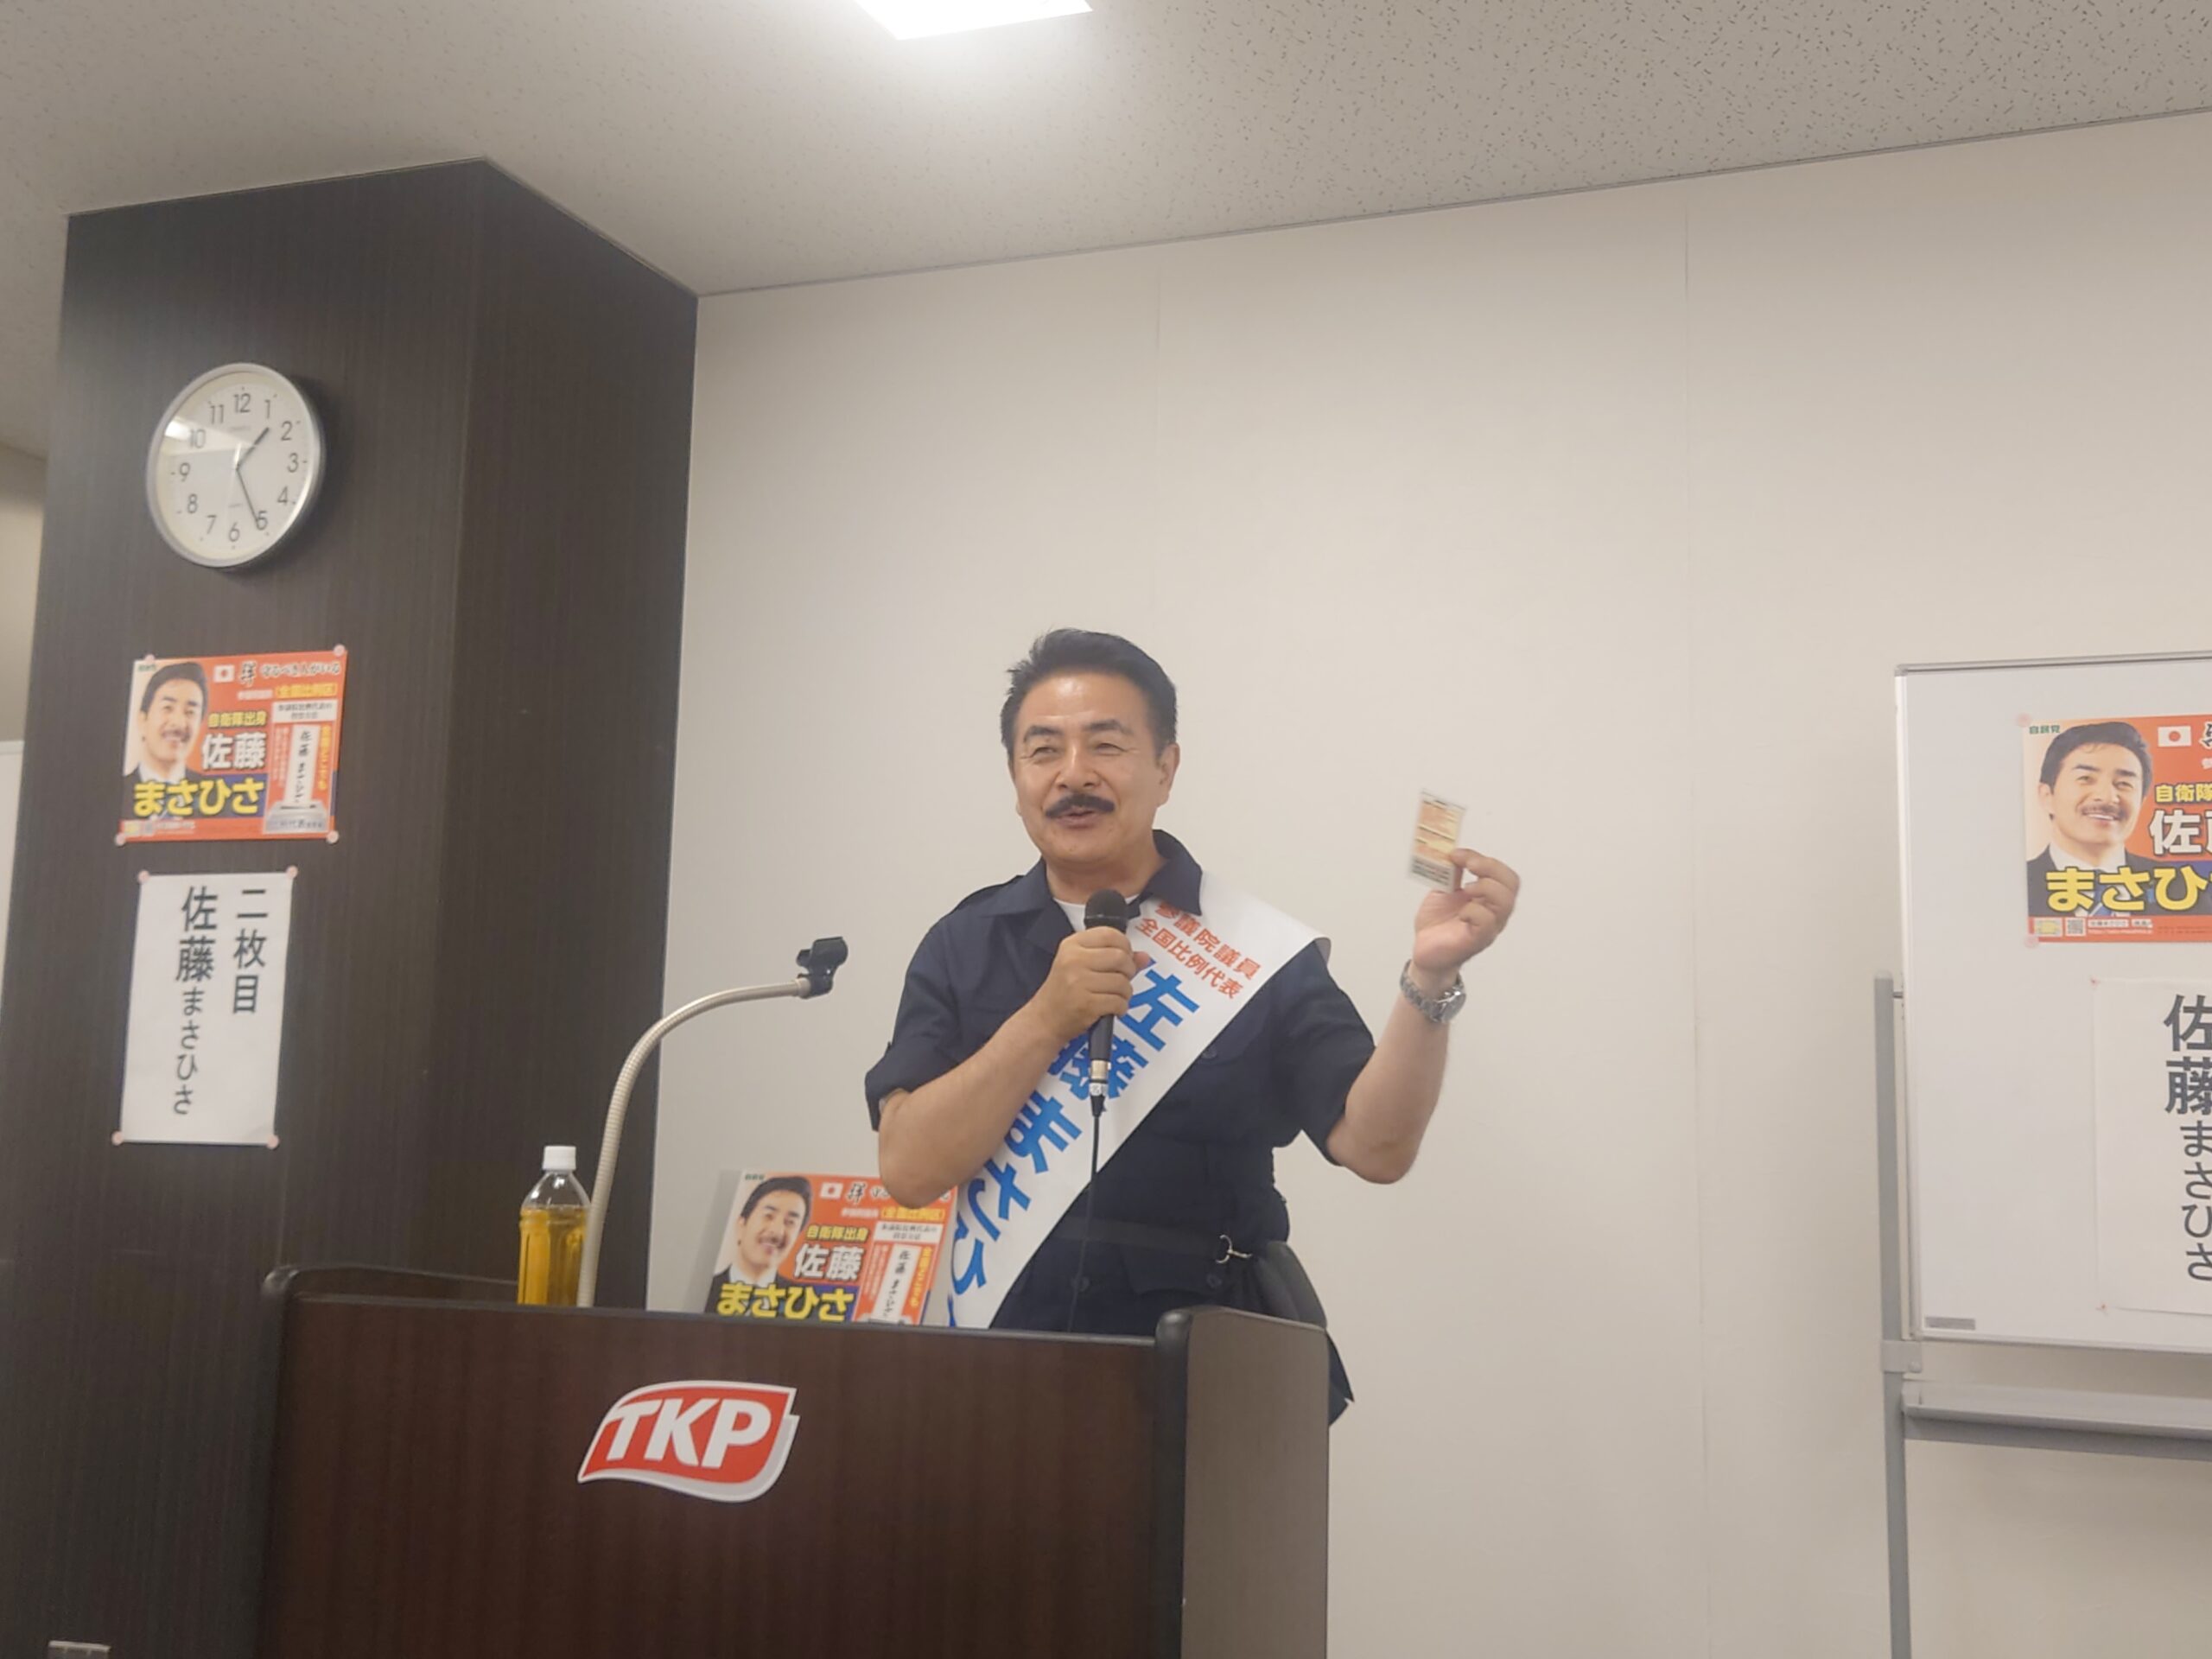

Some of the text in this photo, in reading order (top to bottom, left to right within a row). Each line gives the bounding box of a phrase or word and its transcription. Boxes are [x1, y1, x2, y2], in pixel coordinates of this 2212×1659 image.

[233, 393, 251, 413] 12
[264, 399, 271, 419] 1
[211, 404, 225, 424] 11
[190, 429, 207, 448] 10
[281, 421, 293, 441] 2
[179, 462, 191, 482] 9
[287, 453, 299, 473] 3
[187, 493, 199, 513] 8
[276, 486, 289, 505] 4
[207, 515, 218, 535] 7
[257, 510, 269, 531] 5
[228, 522, 241, 542] 6
[208, 711, 267, 728] 自衛隊出身
[2029, 724, 2061, 735] 自民党
[201, 731, 267, 770] 佐藤
[134, 778, 264, 817] まさひさ
[2148, 809, 2212, 856] 佐
[2045, 865, 2212, 912] まさひ
[232, 888, 269, 1014] 二枚目
[1135, 917, 1244, 1000] 全国比例代表
[173, 885, 219, 1116] 佐藤まさひさ
[805, 1224, 870, 1243] 自衛隊出身
[793, 1243, 866, 1281] 佐藤
[716, 1281, 855, 1323] まさひさ
[605, 1397, 772, 1469] TKP
